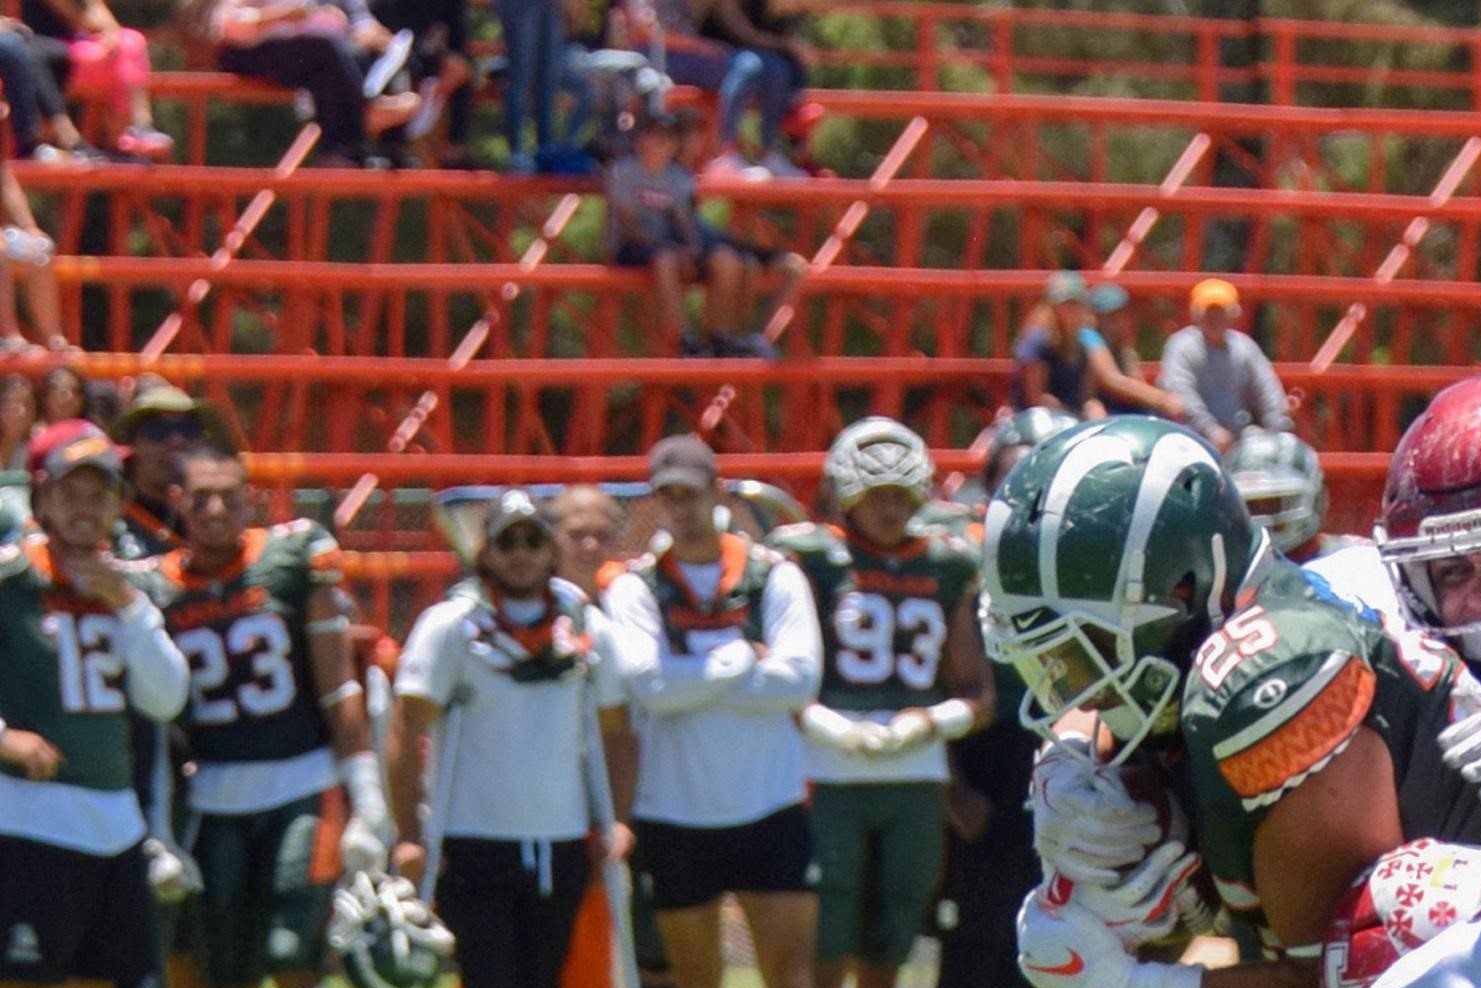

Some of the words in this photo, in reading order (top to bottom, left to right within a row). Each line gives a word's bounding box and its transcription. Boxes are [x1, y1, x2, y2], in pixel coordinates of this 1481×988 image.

[44, 610, 127, 714] 12
[174, 610, 296, 724] 23
[833, 592, 946, 690] 93
[1195, 604, 1278, 692] 25
